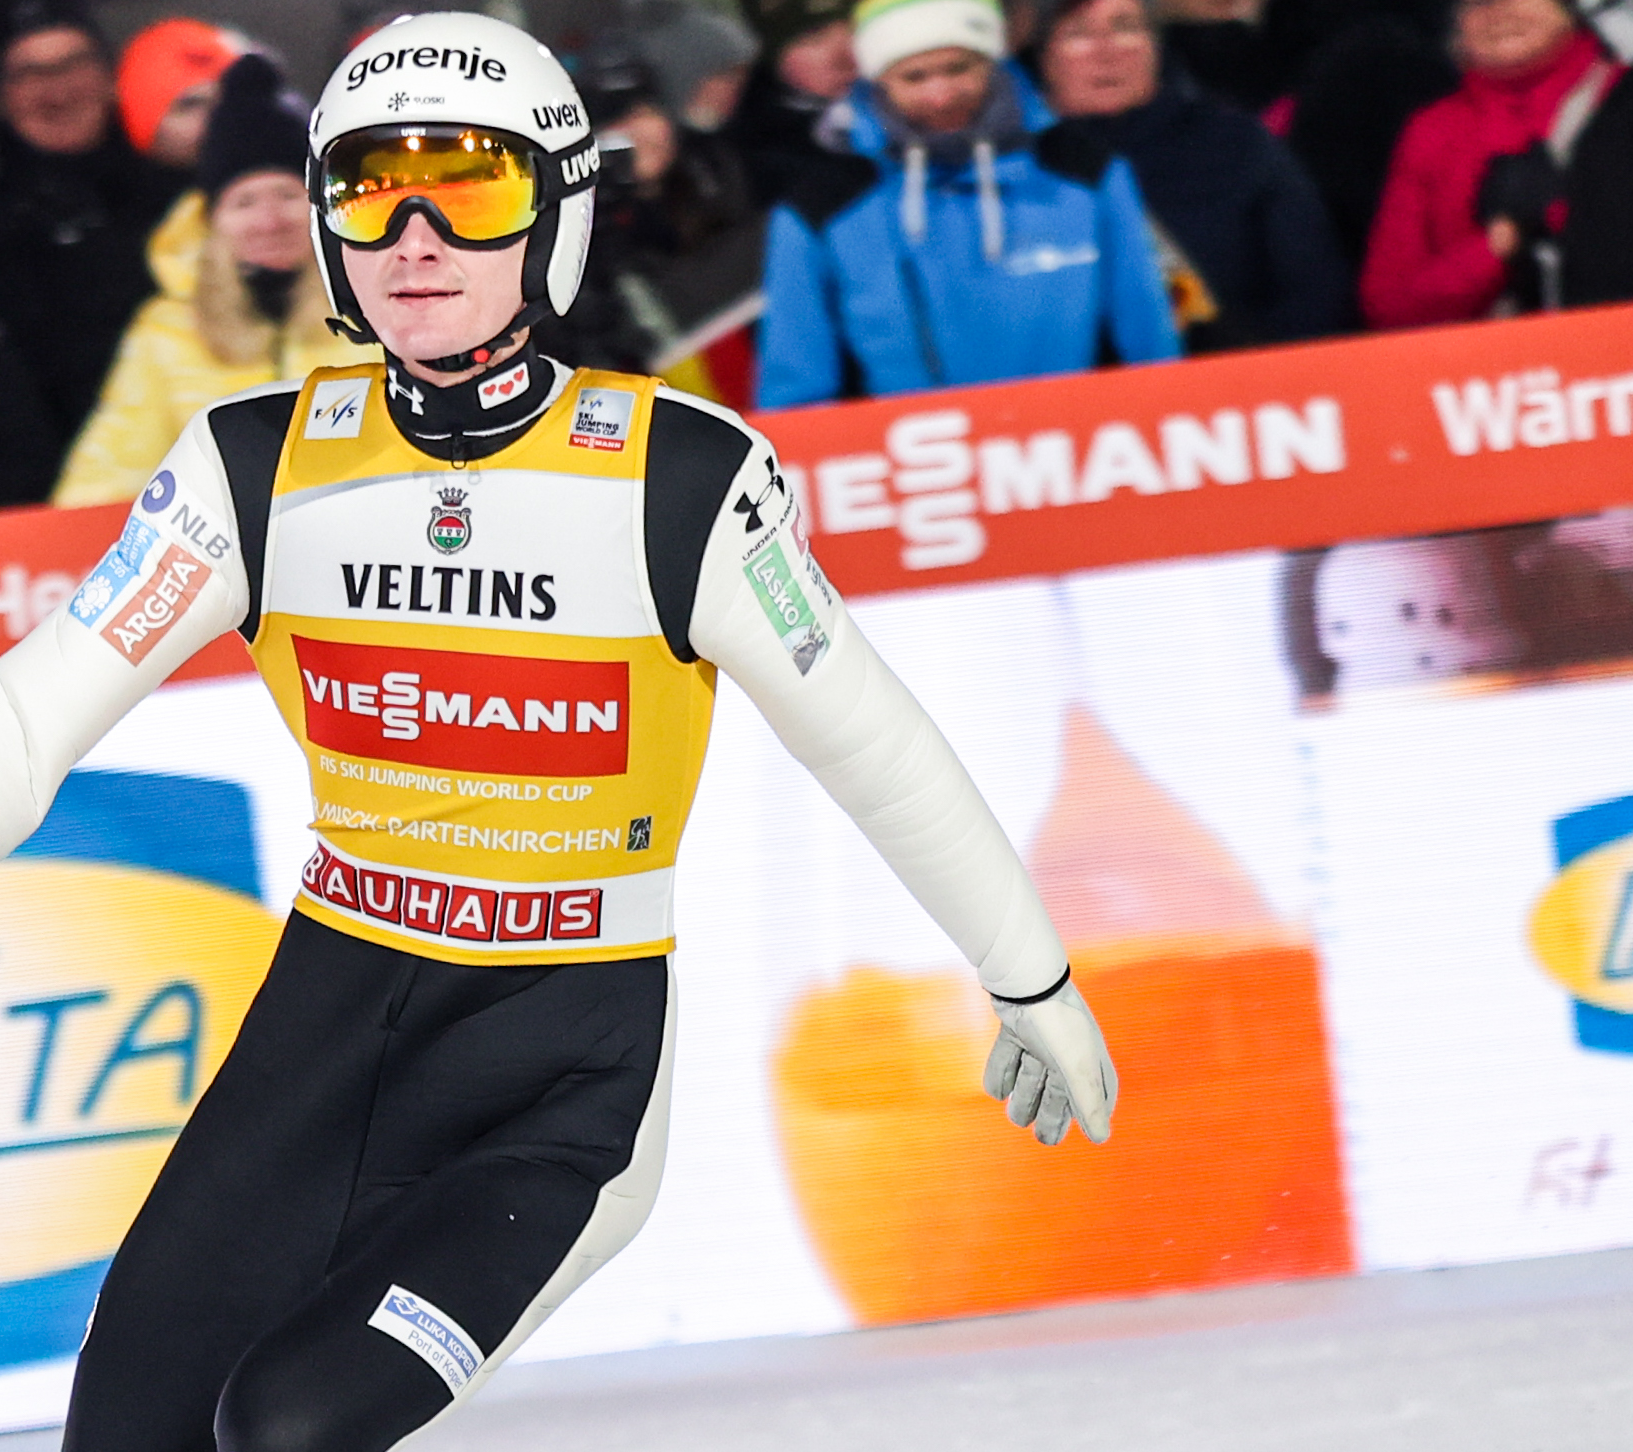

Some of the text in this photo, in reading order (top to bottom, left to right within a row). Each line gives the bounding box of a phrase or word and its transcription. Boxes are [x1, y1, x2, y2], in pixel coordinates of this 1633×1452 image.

[346, 46, 507, 91] gorenje
[532, 104, 582, 131] uvex
[560, 145, 600, 186] uve
[576, 418, 620, 431] JUMPING
[576, 426, 601, 434] WORLD
[781, 408, 1348, 572] IESSMANN
[170, 503, 231, 560] NLB
[742, 527, 778, 561] UNDER
[112, 561, 199, 655] ARGETA
[340, 563, 556, 621] VELTINS
[302, 670, 619, 741] VIESSMANN
[319, 754, 594, 803] FIS SKI JUMPING WORLD CUP
[302, 848, 594, 935] BAUHAUS
[408, 1330, 464, 1389] Port of Koper
[417, 1314, 476, 1374] LUKA KOPER
